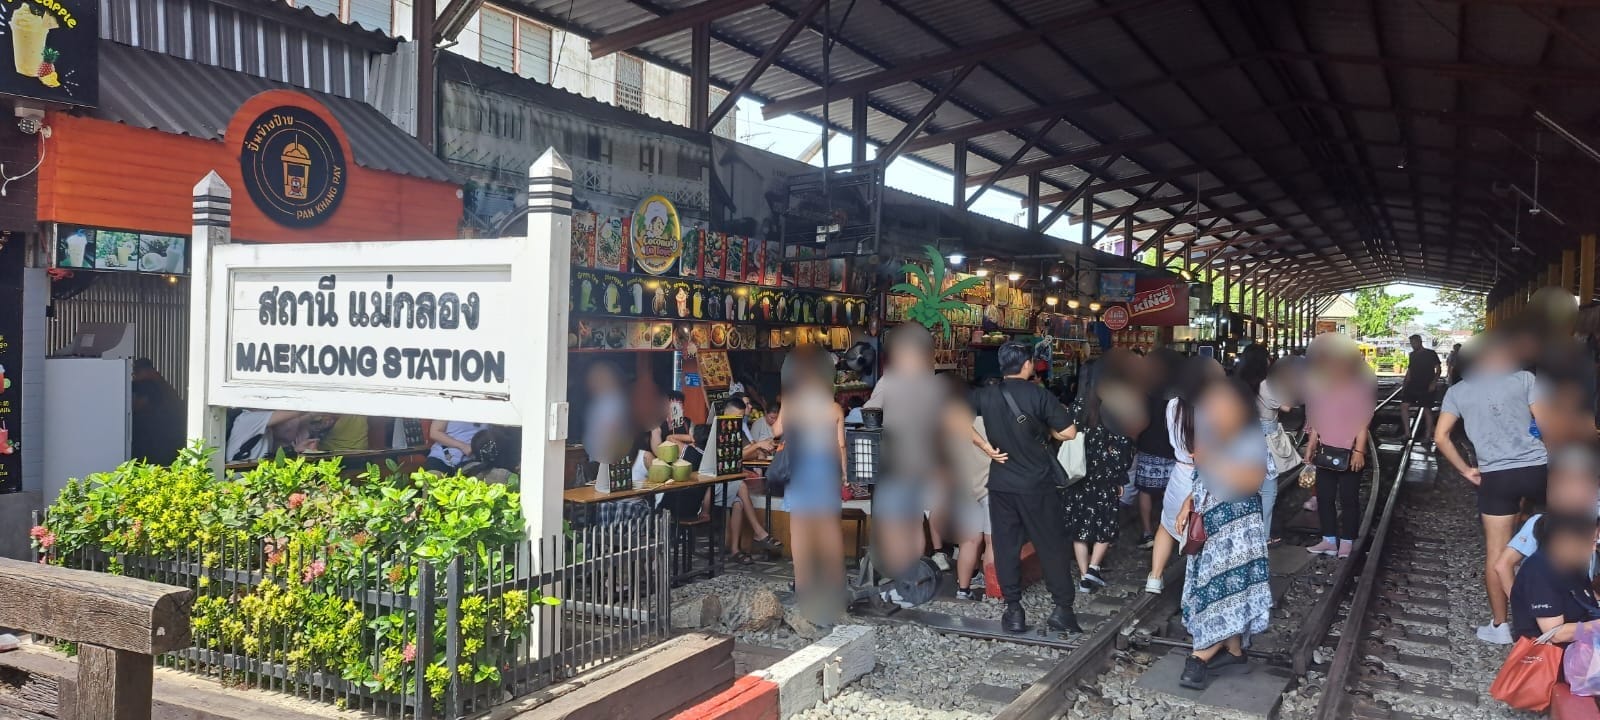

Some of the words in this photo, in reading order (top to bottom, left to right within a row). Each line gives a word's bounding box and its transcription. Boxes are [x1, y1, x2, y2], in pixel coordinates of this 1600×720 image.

[296, 208, 315, 220] PAN
[315, 186, 338, 214] KHANG
[332, 165, 341, 185] PAY
[258, 274, 339, 327] สถานี
[349, 274, 480, 330] แม่กลอง
[236, 342, 378, 377] MAEKLONG
[382, 346, 505, 383] STATION
